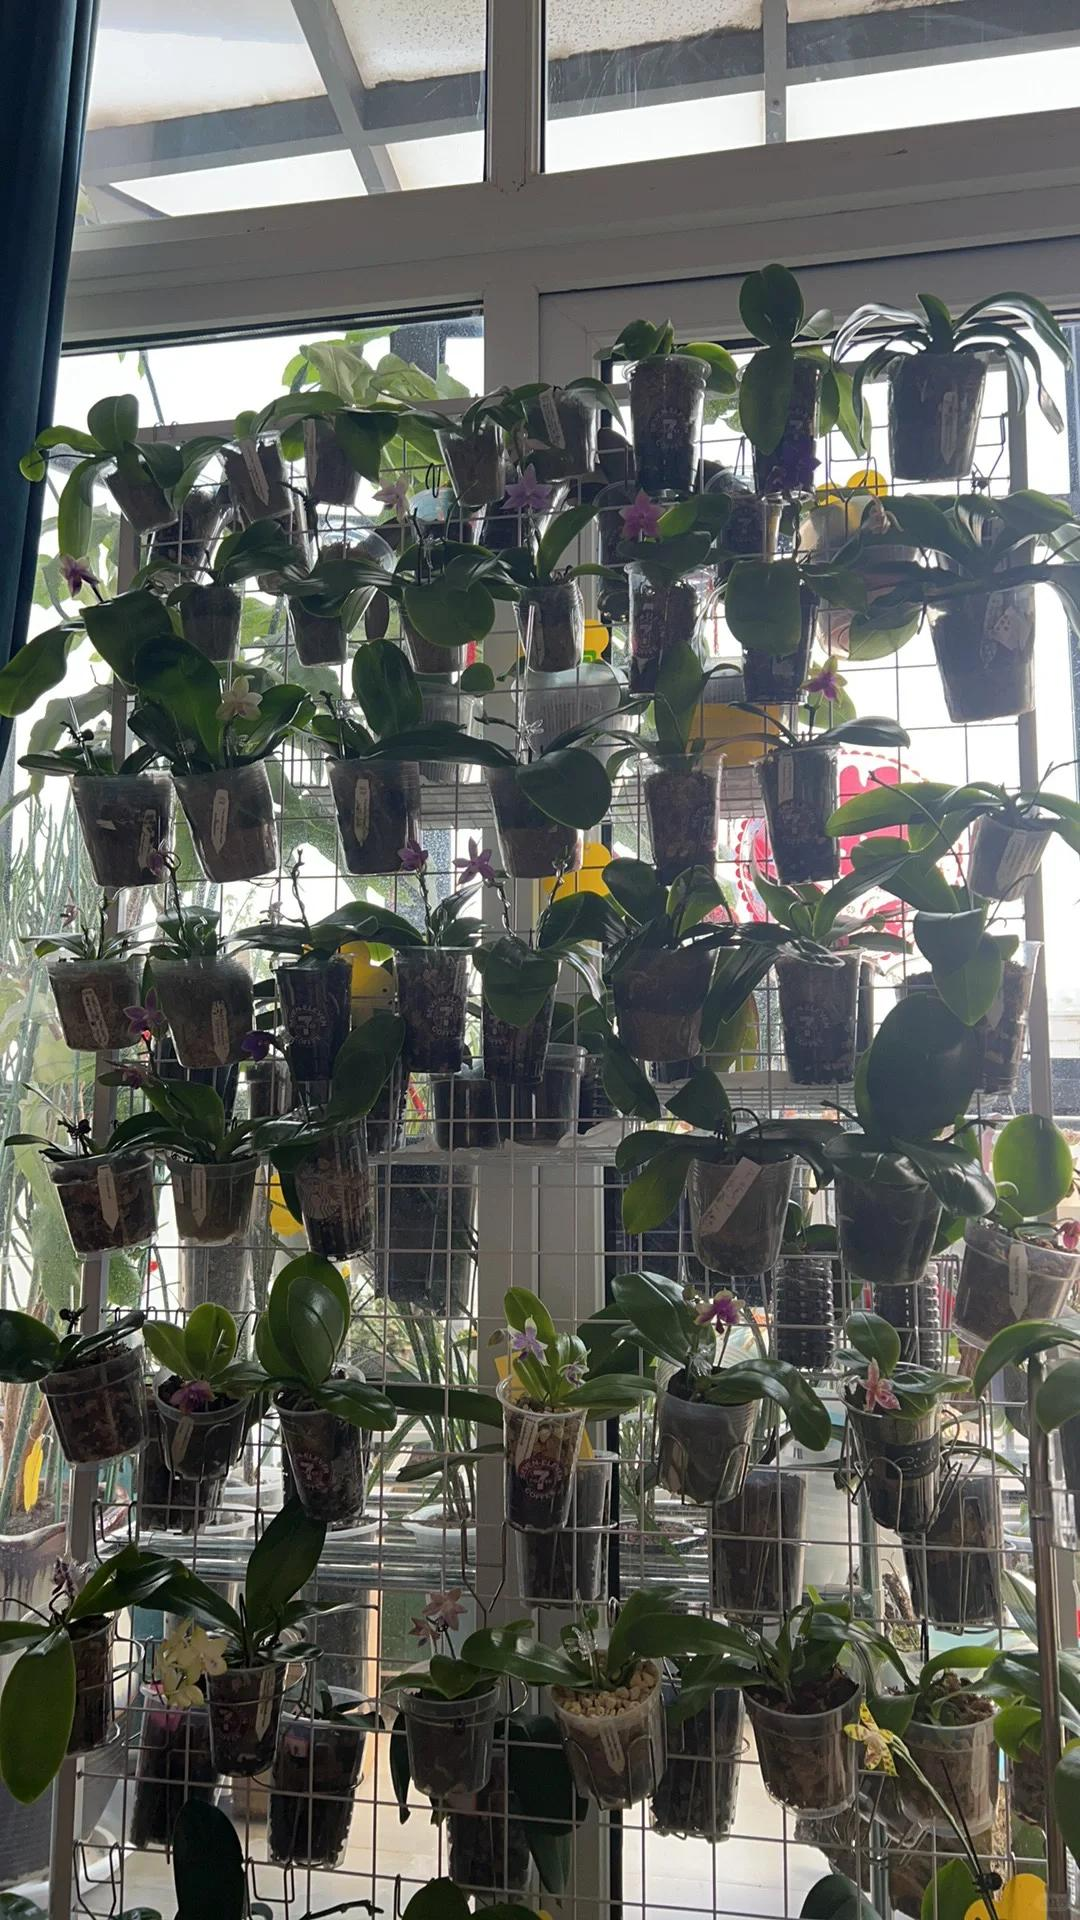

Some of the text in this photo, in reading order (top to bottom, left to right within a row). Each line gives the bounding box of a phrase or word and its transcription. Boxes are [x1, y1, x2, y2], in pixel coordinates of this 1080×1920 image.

[662, 419, 677, 439] 7
[298, 1015, 312, 1035] 7
[440, 1006, 453, 1026] 7
[800, 1015, 815, 1037] 7
[300, 1461, 314, 1481] 7
[533, 1470, 550, 1490] 7
